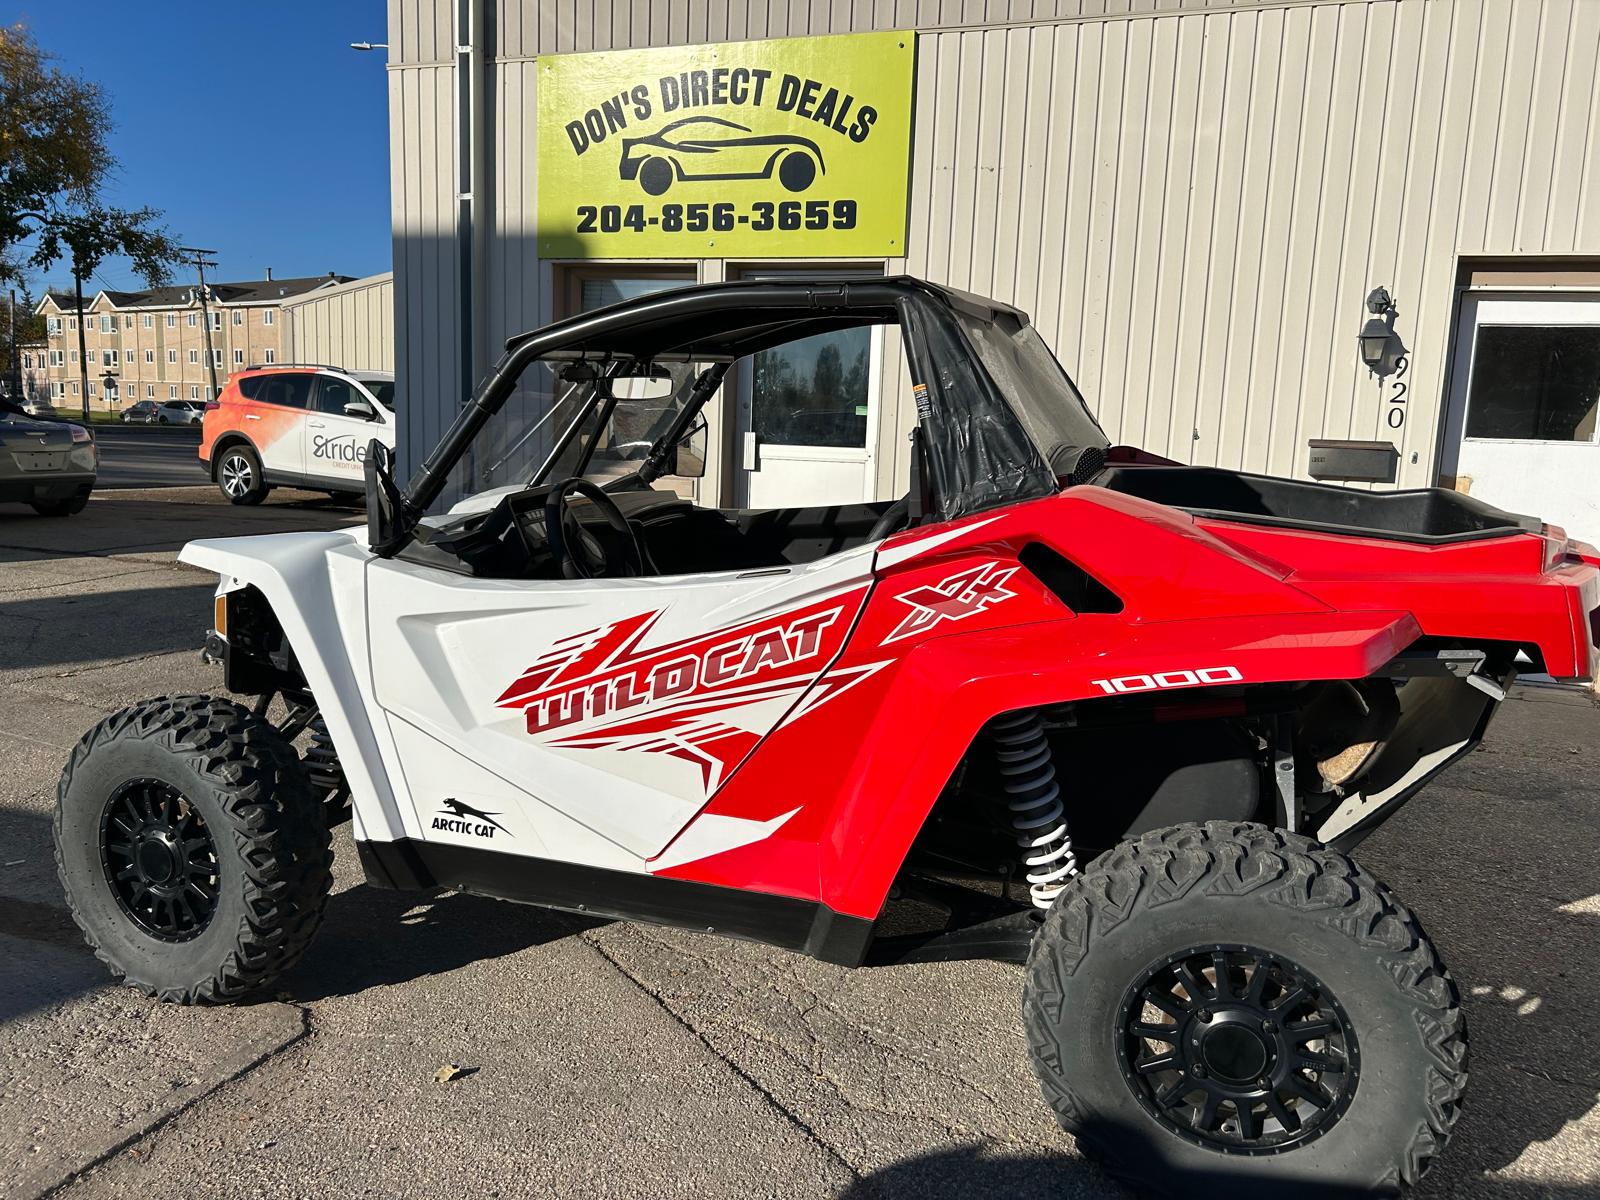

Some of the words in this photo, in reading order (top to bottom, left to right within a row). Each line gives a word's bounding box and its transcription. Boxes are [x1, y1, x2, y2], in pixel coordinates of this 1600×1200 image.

[565, 84, 652, 156] DON'S
[659, 67, 772, 113] DIRECT
[776, 73, 878, 144] DEALS
[576, 200, 857, 233] 204-856-3659
[1387, 356, 1409, 429] 920
[313, 434, 367, 462] Stride
[524, 604, 846, 735] WILDCAT
[1091, 665, 1244, 694] 1000
[431, 817, 472, 835] ARCTIC
[474, 824, 496, 838] CAT
